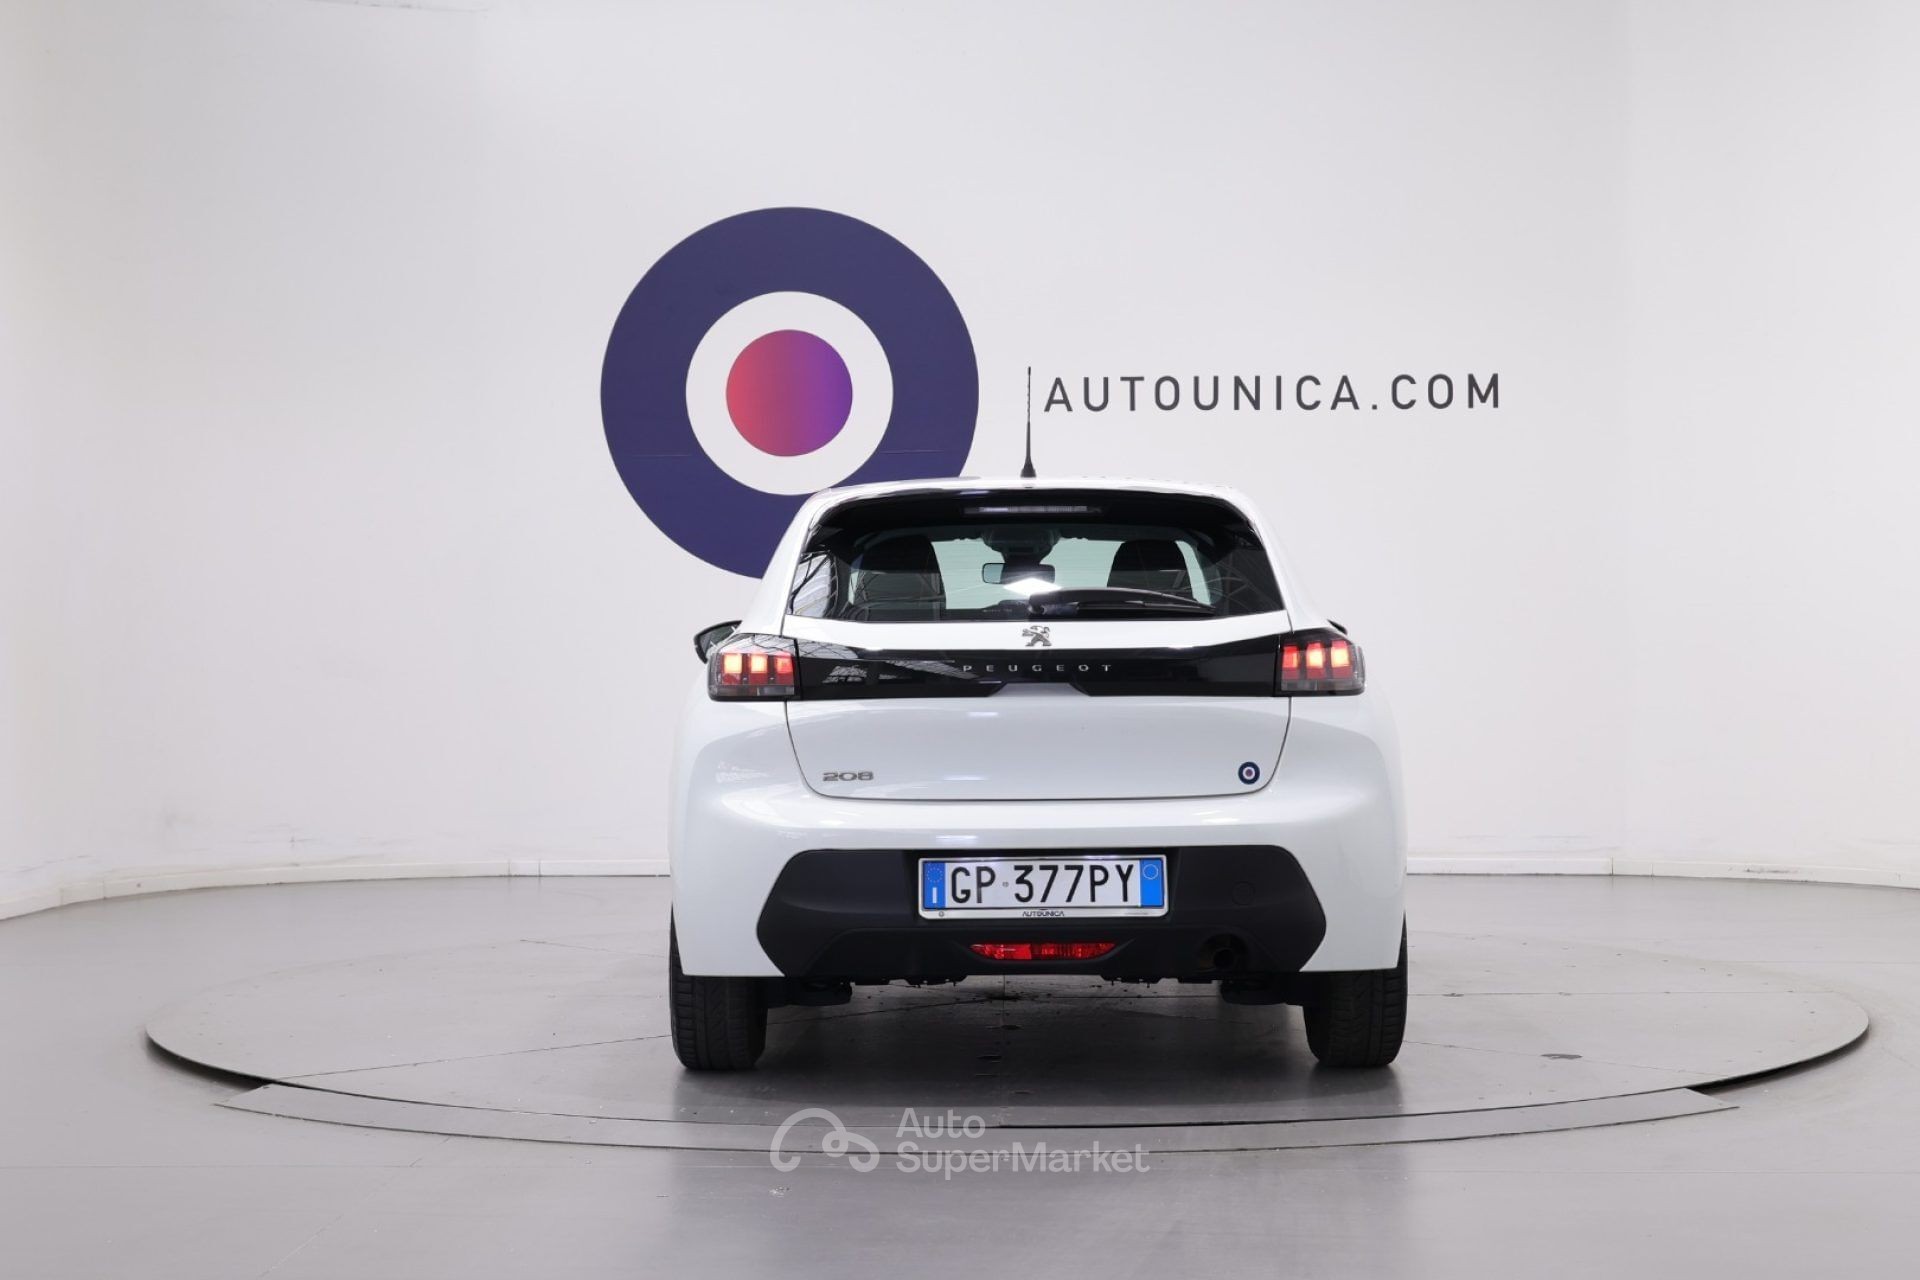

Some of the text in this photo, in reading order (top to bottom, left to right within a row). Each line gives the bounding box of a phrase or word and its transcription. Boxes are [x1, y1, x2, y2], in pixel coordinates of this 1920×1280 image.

[1043, 373, 1500, 413] AUTOUNICA.COM
[962, 664, 1112, 673] PEUGEOT
[822, 771, 874, 782] 208
[951, 864, 1134, 904] GP 377PY
